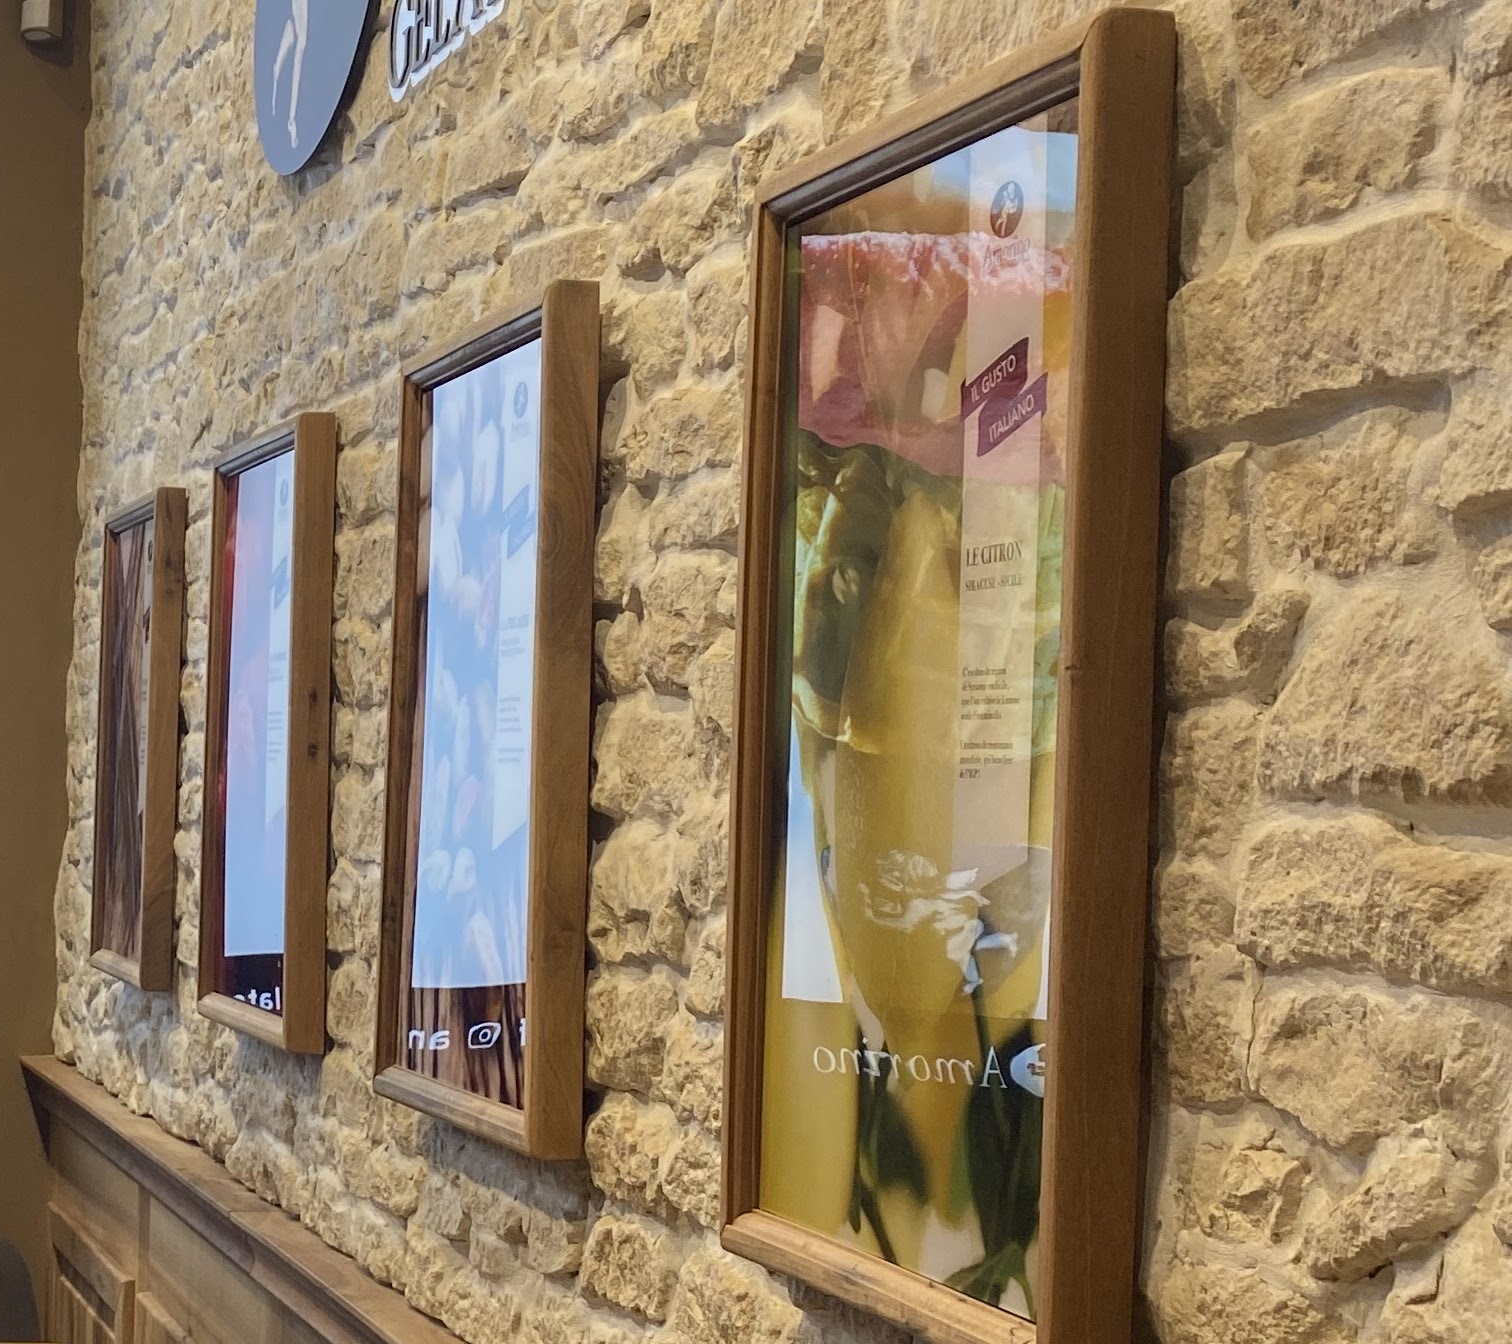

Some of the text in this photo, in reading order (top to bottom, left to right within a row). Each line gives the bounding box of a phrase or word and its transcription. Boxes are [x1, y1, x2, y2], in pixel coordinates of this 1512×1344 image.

[970, 354, 1016, 403] IL GUSTO
[989, 394, 1035, 442] ITALIANO
[981, 540, 1023, 564] CITRON
